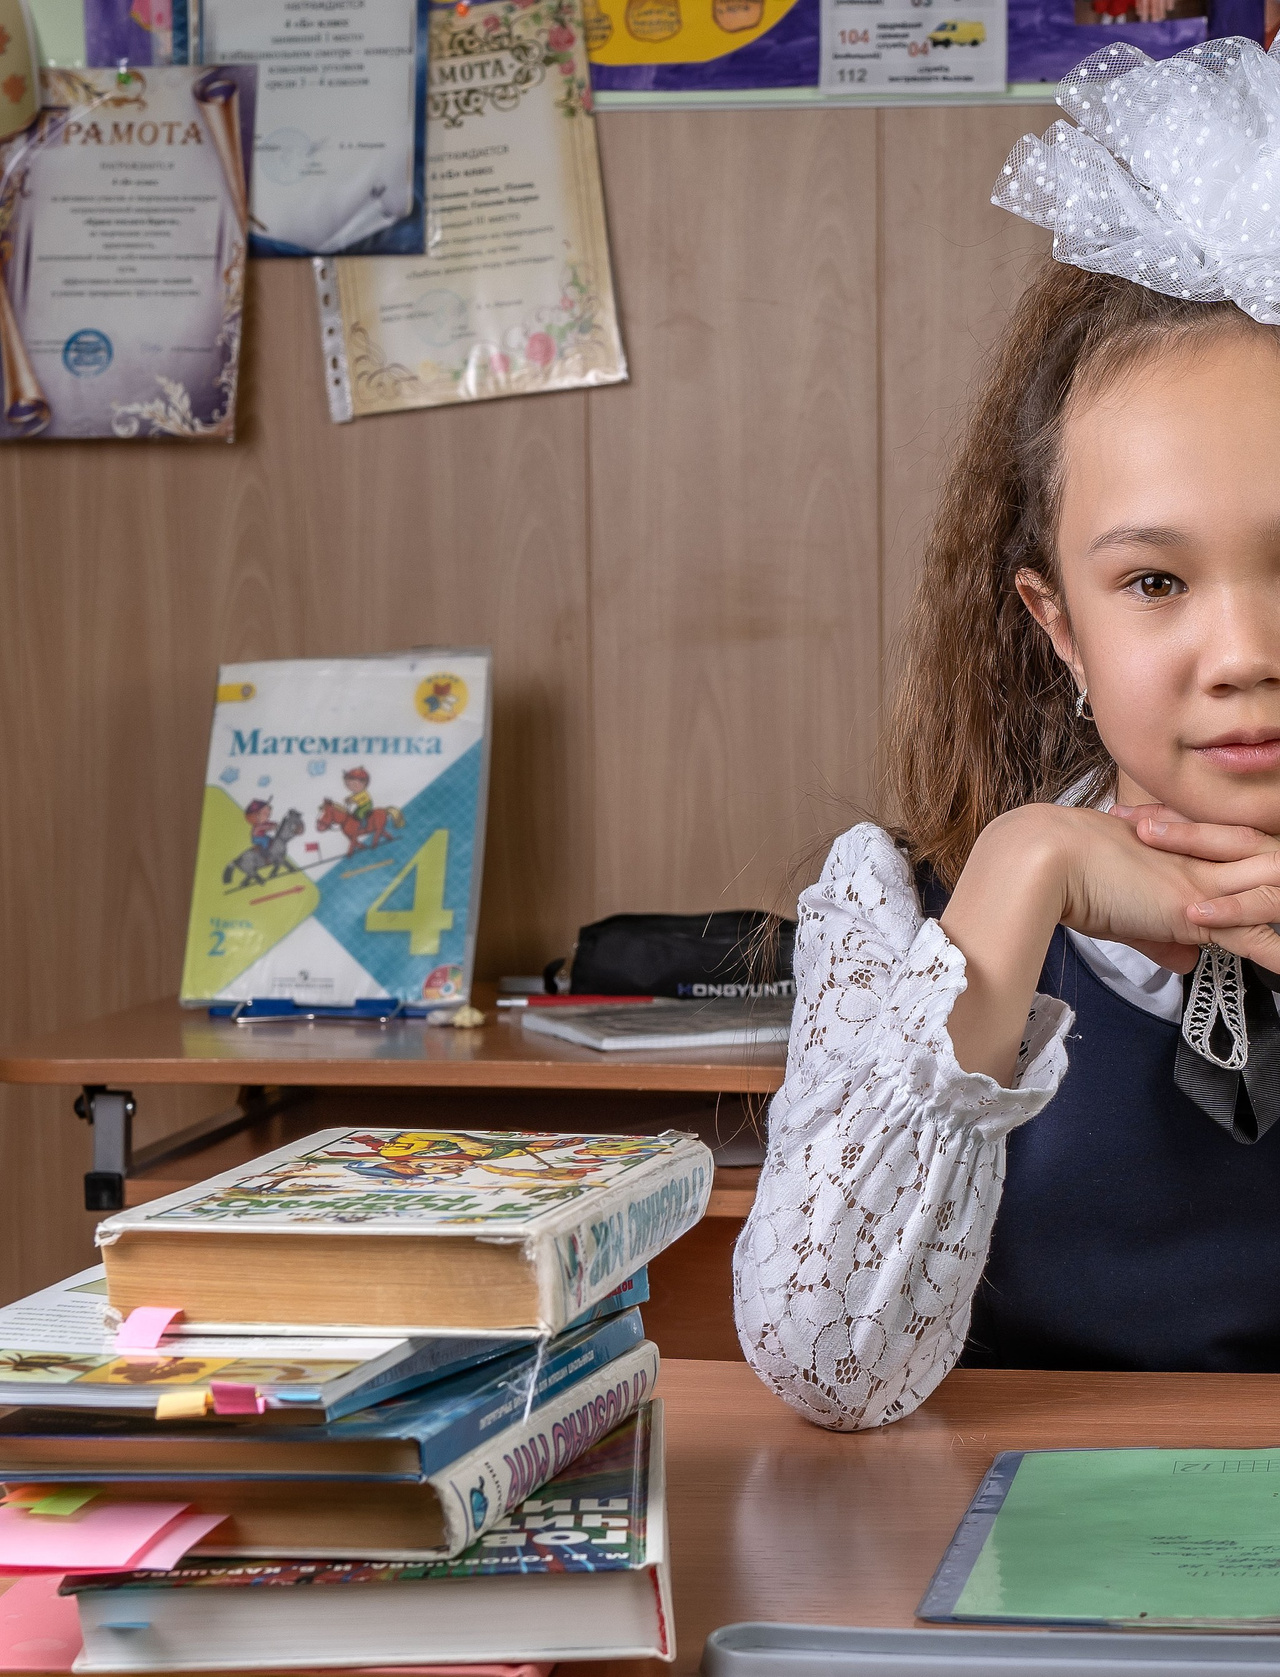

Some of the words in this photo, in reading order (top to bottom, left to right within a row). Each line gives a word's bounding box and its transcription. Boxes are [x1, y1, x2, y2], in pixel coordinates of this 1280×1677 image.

[838, 29, 870, 45] 104
[907, 40, 930, 58] 04
[437, 59, 506, 84] МОТА
[837, 67, 867, 84] 112
[228, 728, 443, 757] Математика
[364, 829, 454, 956] 4
[206, 930, 227, 957] 2
[677, 980, 797, 998] HONGYUNT
[217, 1199, 481, 1213] ПОЗНАЮ
[334, 1193, 477, 1204] МИР
[552, 1381, 631, 1476] ПОЗНАЮ
[522, 1497, 629, 1513] ПИ
[496, 1513, 629, 1530] ЧИТ
[480, 1529, 629, 1547] ГОВ
